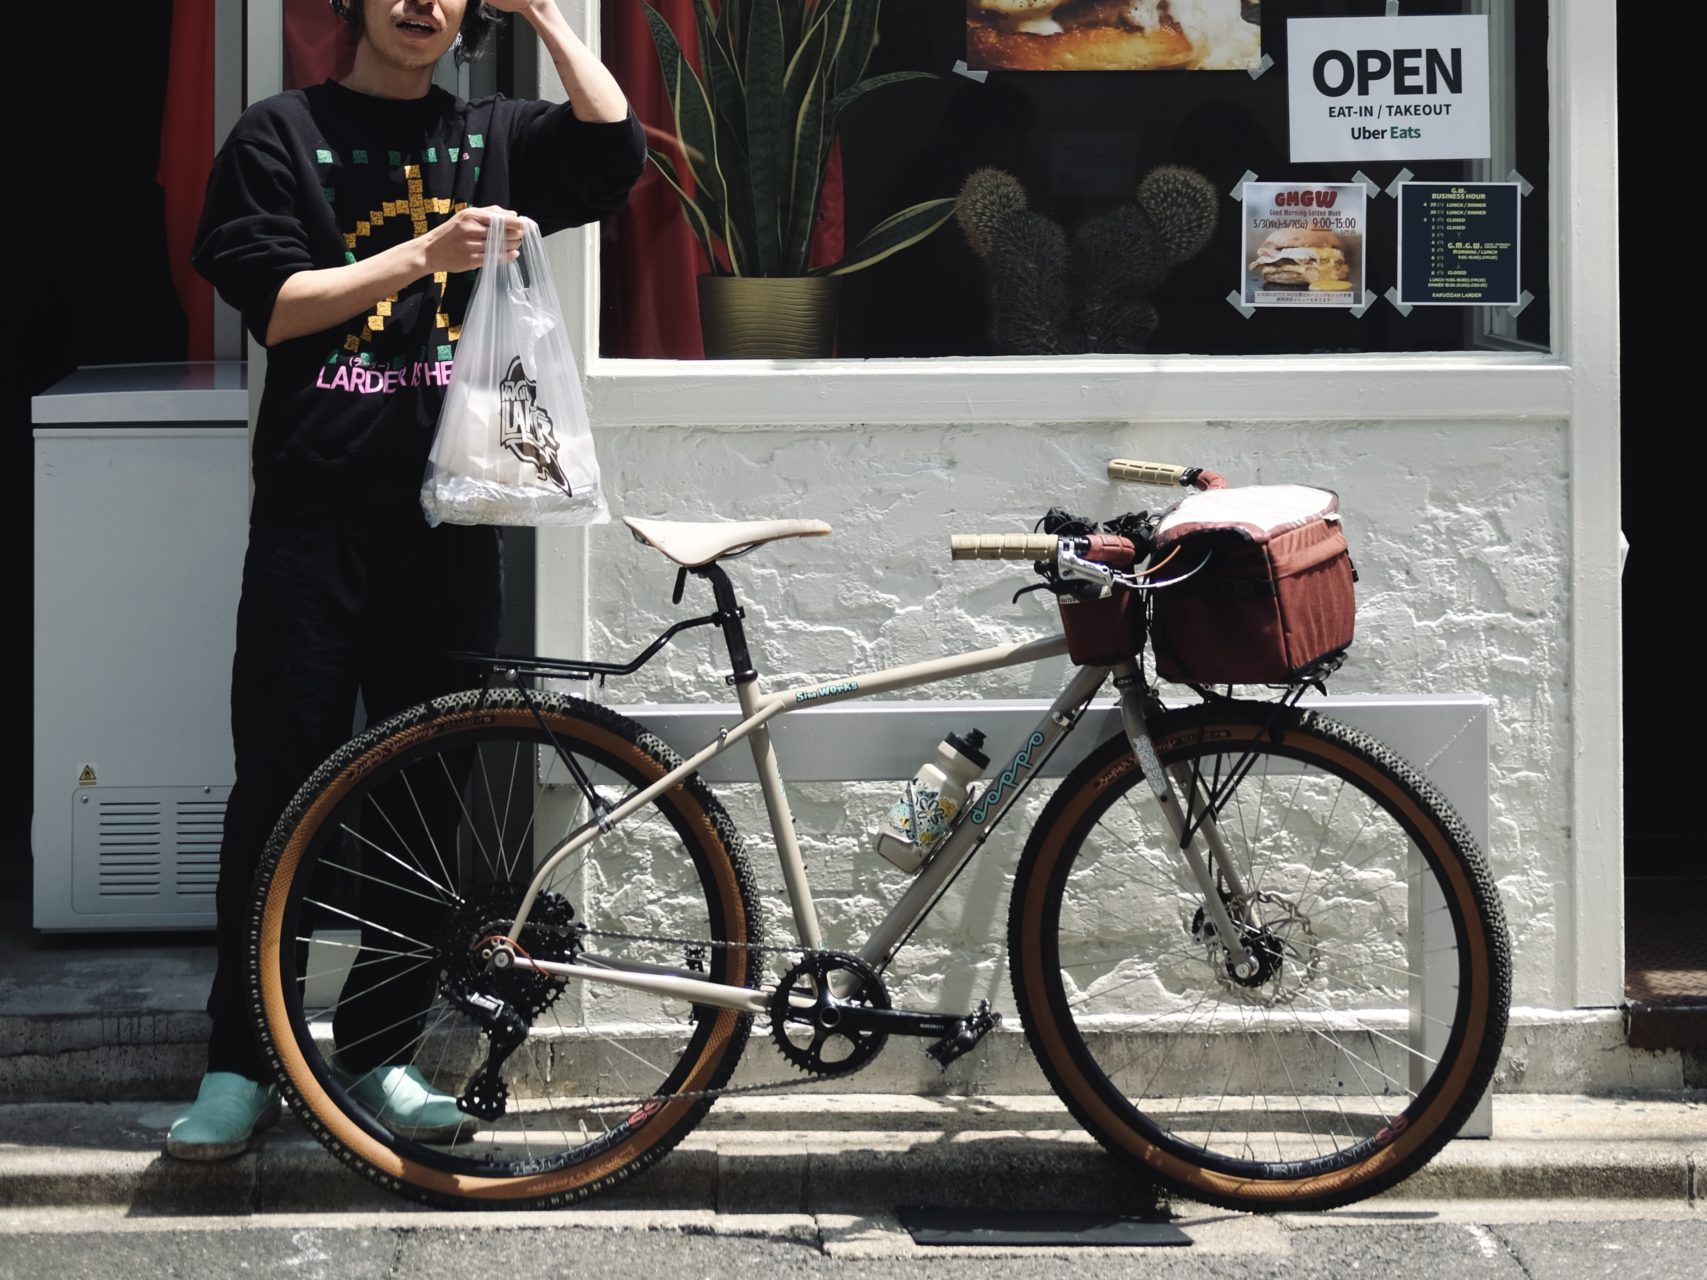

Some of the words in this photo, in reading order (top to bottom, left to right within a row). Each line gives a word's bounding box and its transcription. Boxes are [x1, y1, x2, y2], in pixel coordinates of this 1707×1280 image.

[1313, 48, 1462, 97] OPEN
[1328, 106, 1374, 118] EAT-IN
[1377, 104, 1383, 119] /
[1386, 104, 1452, 117] TAKEOUT
[1351, 126, 1387, 140] Uber
[1390, 126, 1421, 139] Eats
[1275, 191, 1338, 208] GMGW
[1269, 209, 1282, 217] Good
[1308, 209, 1326, 217] Golden
[424, 360, 455, 386] HE
[970, 731, 1045, 824] doppo
